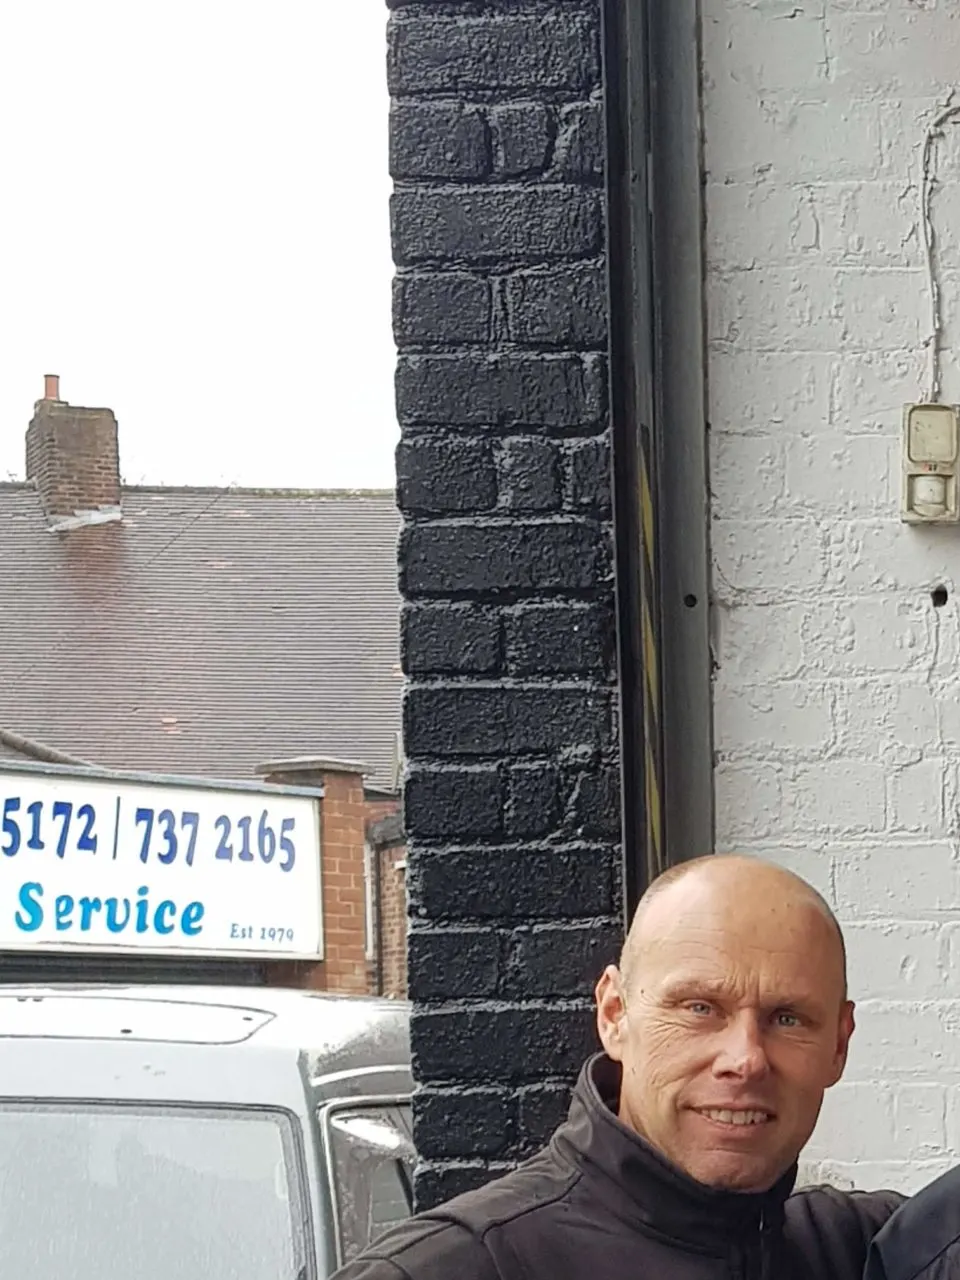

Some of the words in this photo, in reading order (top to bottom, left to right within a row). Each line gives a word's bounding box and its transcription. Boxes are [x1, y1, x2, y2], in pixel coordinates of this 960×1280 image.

[1, 797, 98, 859] 5172
[135, 807, 200, 866] 737
[214, 809, 296, 872] 2165
[15, 881, 205, 936] Service
[230, 923, 253, 939] Est
[260, 927, 294, 943] 1979
